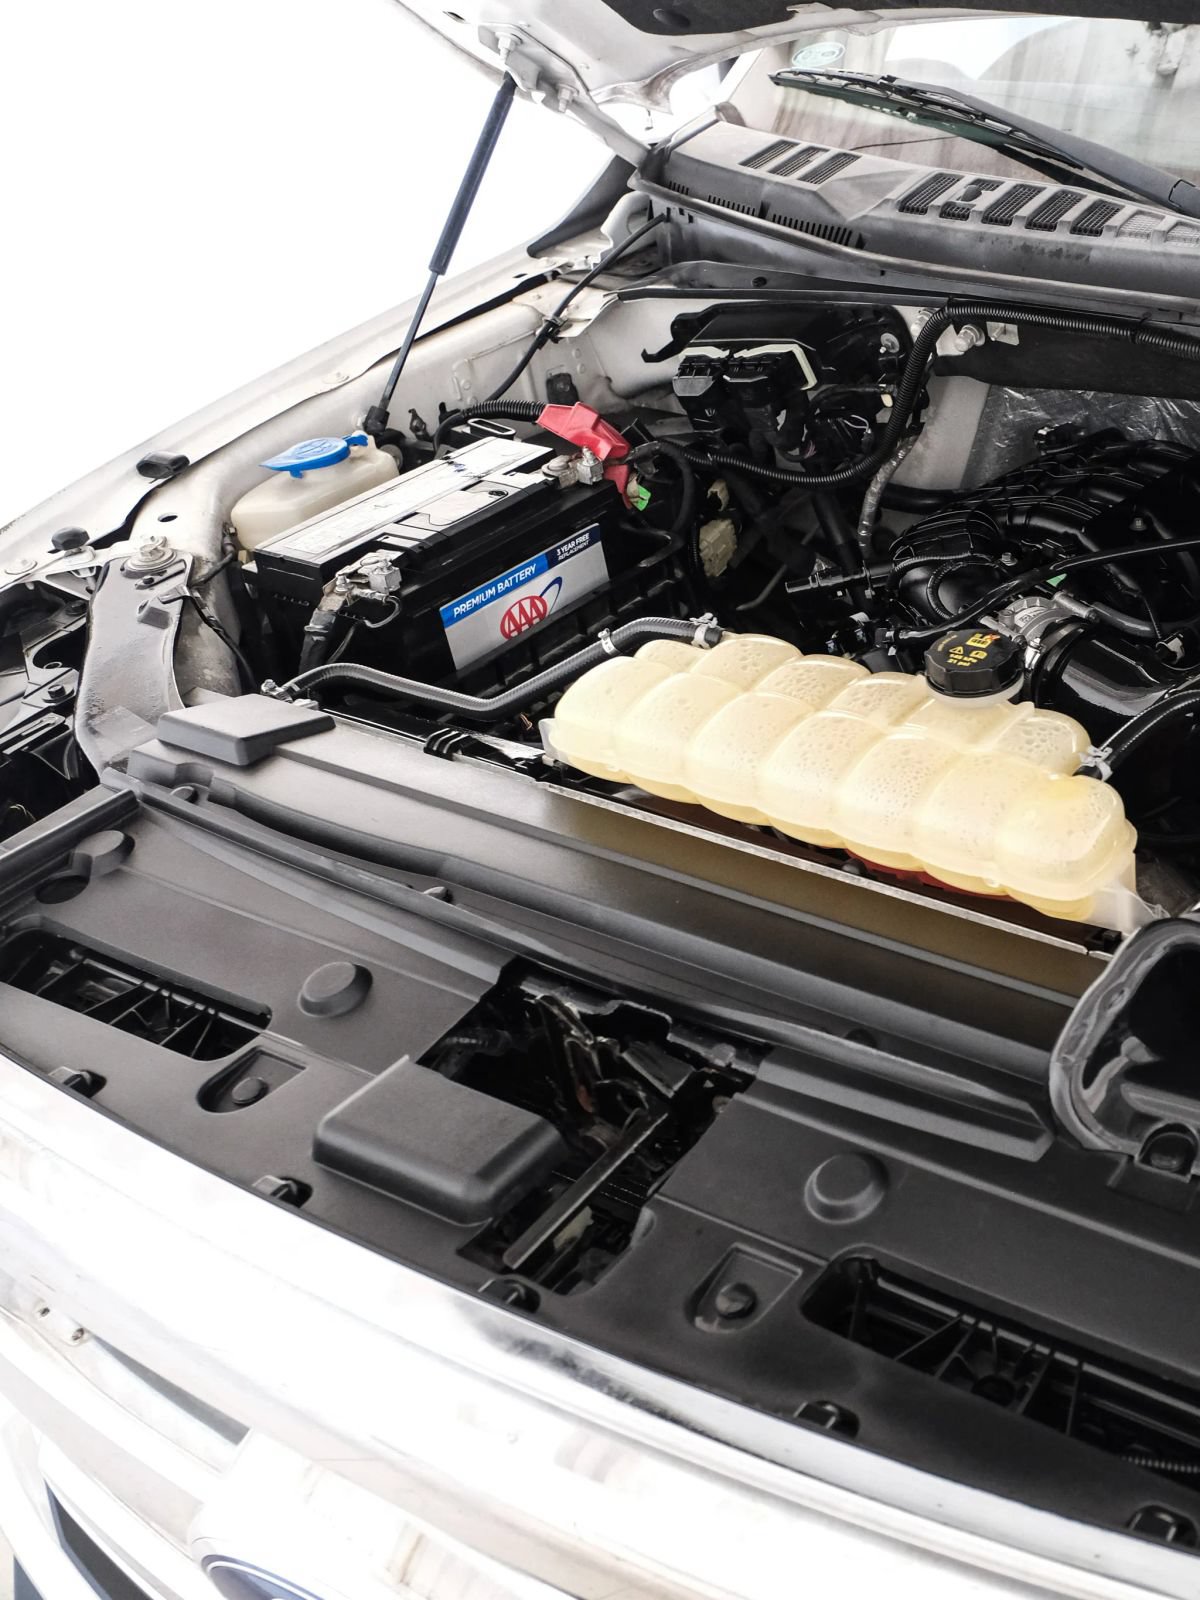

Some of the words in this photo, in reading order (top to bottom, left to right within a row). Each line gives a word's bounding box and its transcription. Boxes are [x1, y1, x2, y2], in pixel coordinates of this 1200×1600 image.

[556, 548, 561, 556] 3
[560, 541, 576, 553] YEAR
[576, 533, 590, 545] FREE
[557, 539, 590, 560] REPLACEMENT
[453, 587, 495, 617] PREMIUM
[497, 564, 537, 593] BATTERY
[506, 599, 545, 638] AAA
